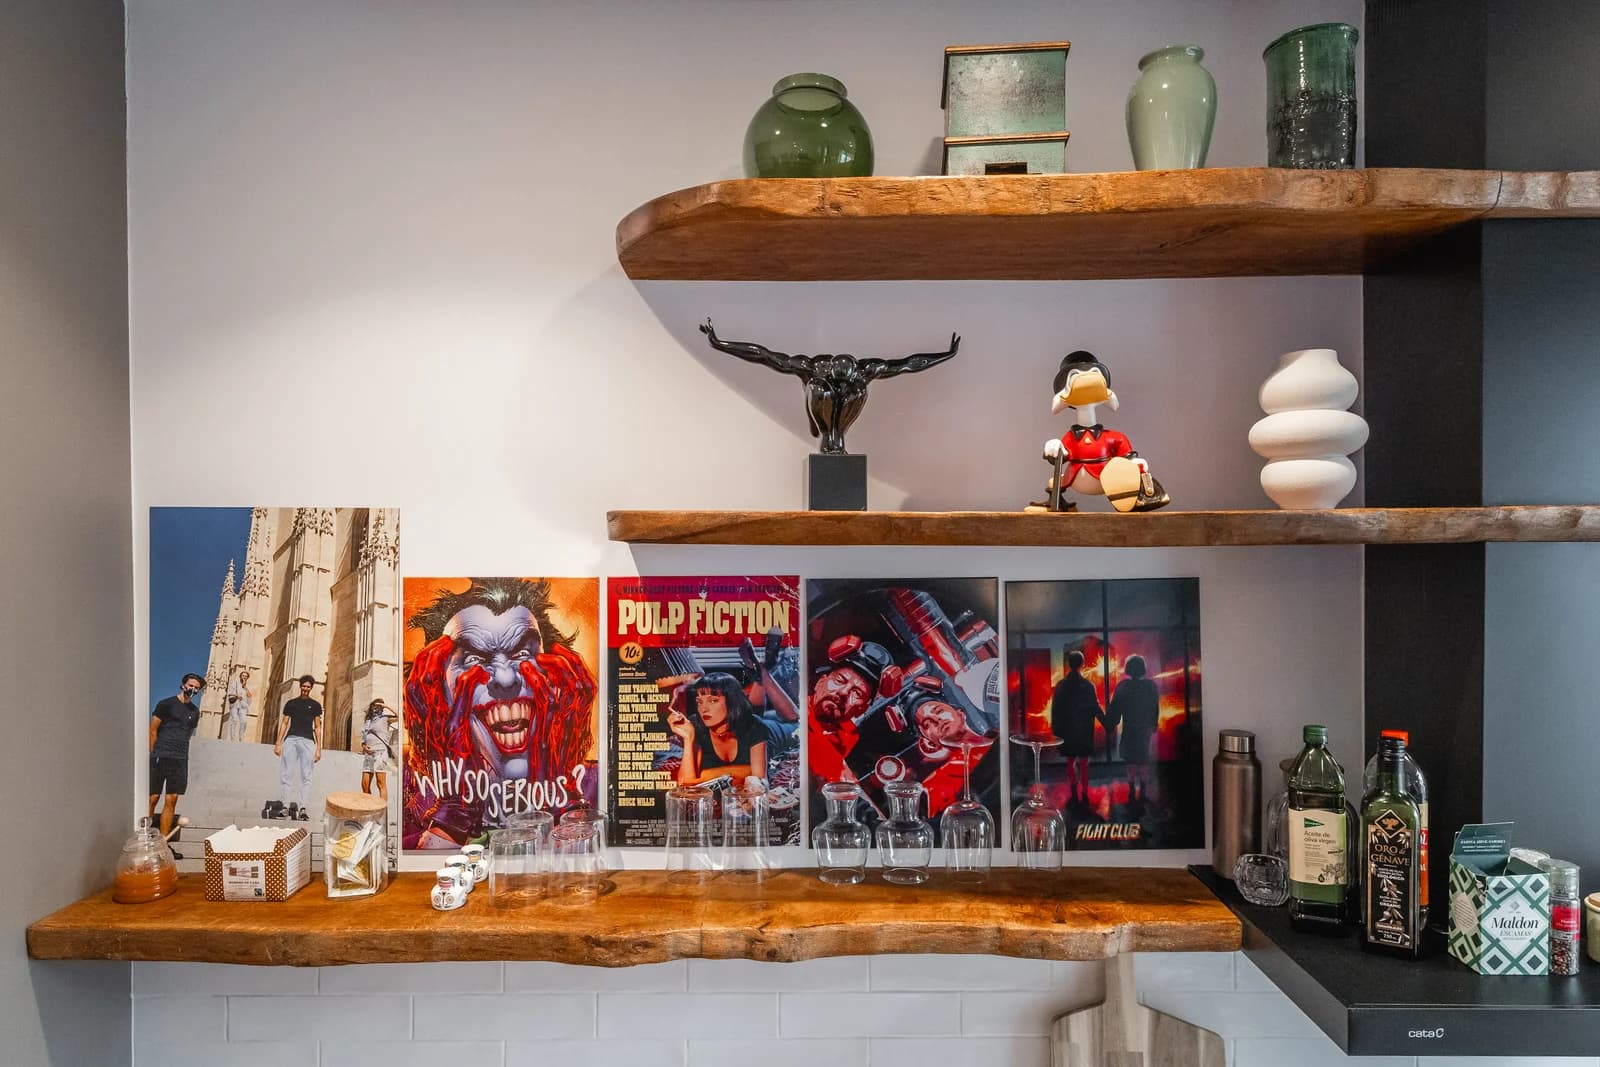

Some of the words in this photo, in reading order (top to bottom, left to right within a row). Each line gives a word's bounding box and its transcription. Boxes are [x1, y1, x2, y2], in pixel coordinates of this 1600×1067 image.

[617, 599, 685, 636] PULP
[688, 598, 790, 636] FICTION
[414, 757, 464, 799] WHY
[462, 769, 490, 804] SO
[1075, 823, 1112, 840] FIGHT
[1110, 822, 1141, 840] CLUB
[1374, 843, 1398, 855] ORO
[1491, 916, 1540, 929] Maldon
